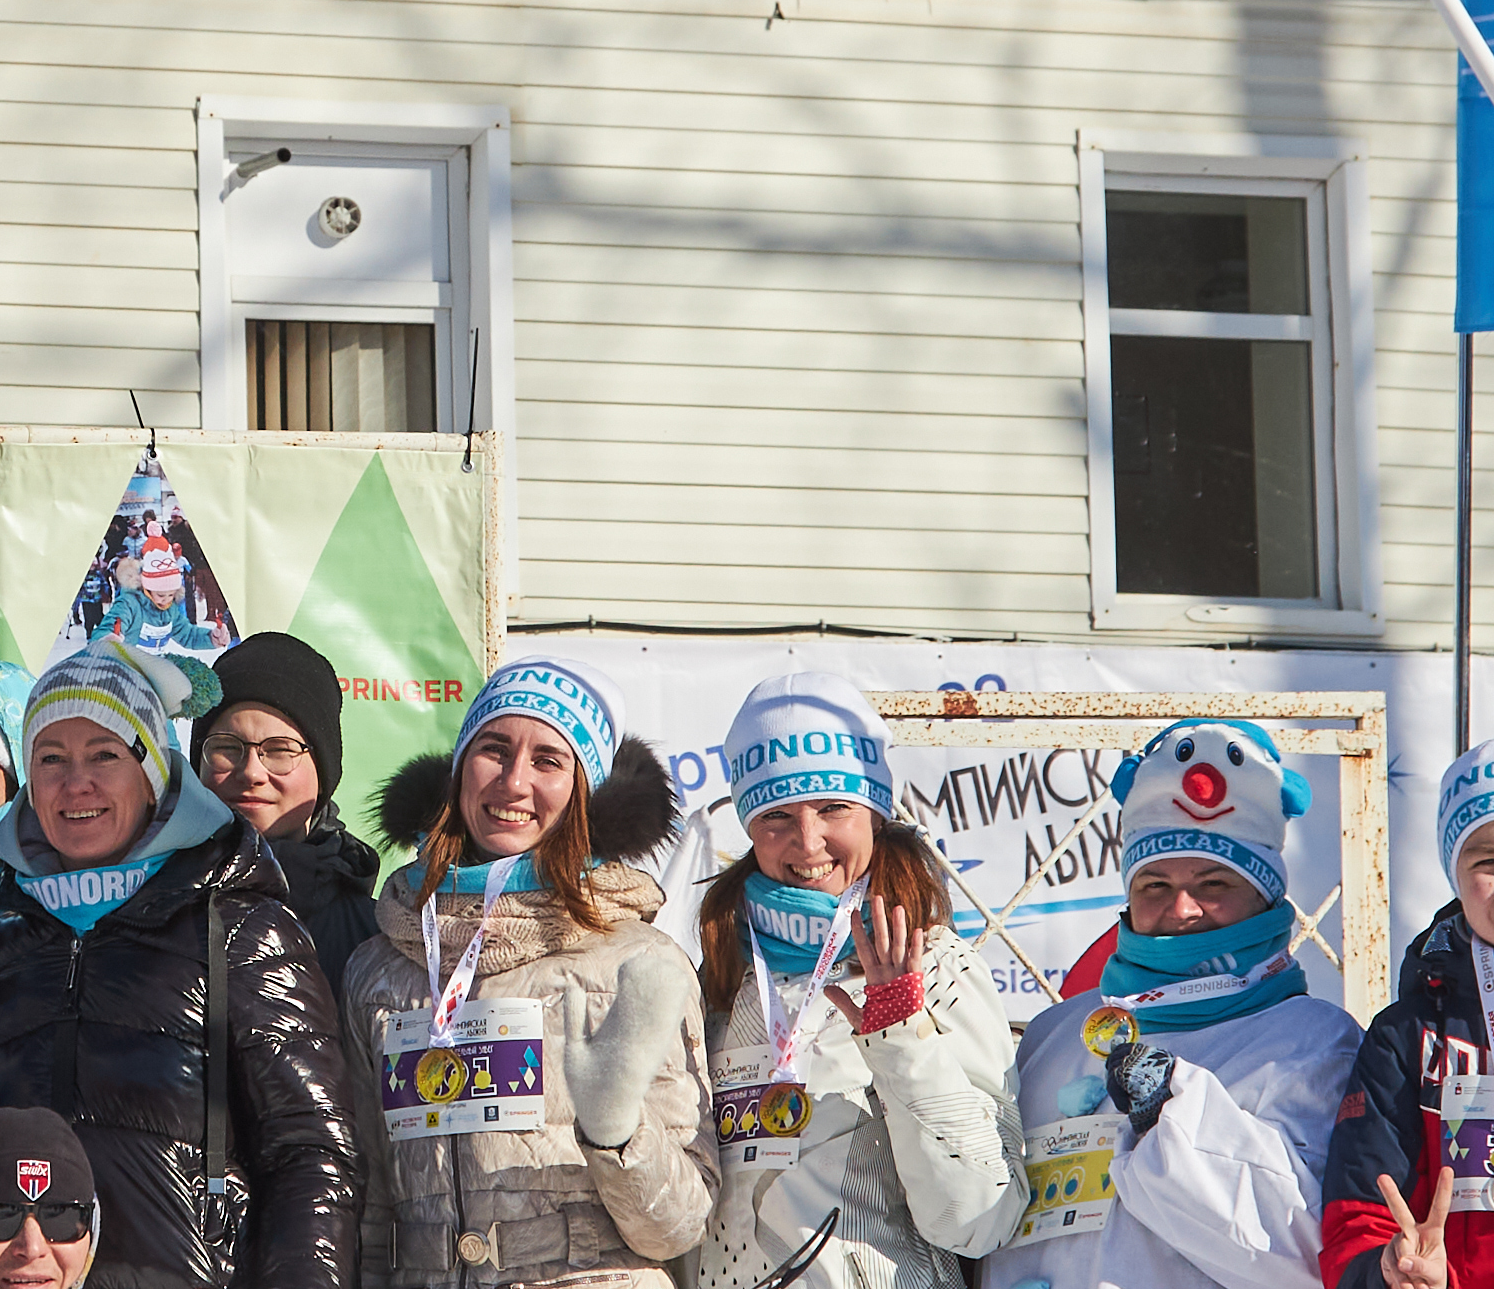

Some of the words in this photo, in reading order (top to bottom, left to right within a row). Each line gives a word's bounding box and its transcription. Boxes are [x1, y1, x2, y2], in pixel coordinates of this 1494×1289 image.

[731, 731, 879, 787] BIONORD
[1178, 977, 1239, 997] SPRINGER
[715, 1100, 760, 1143] 84
